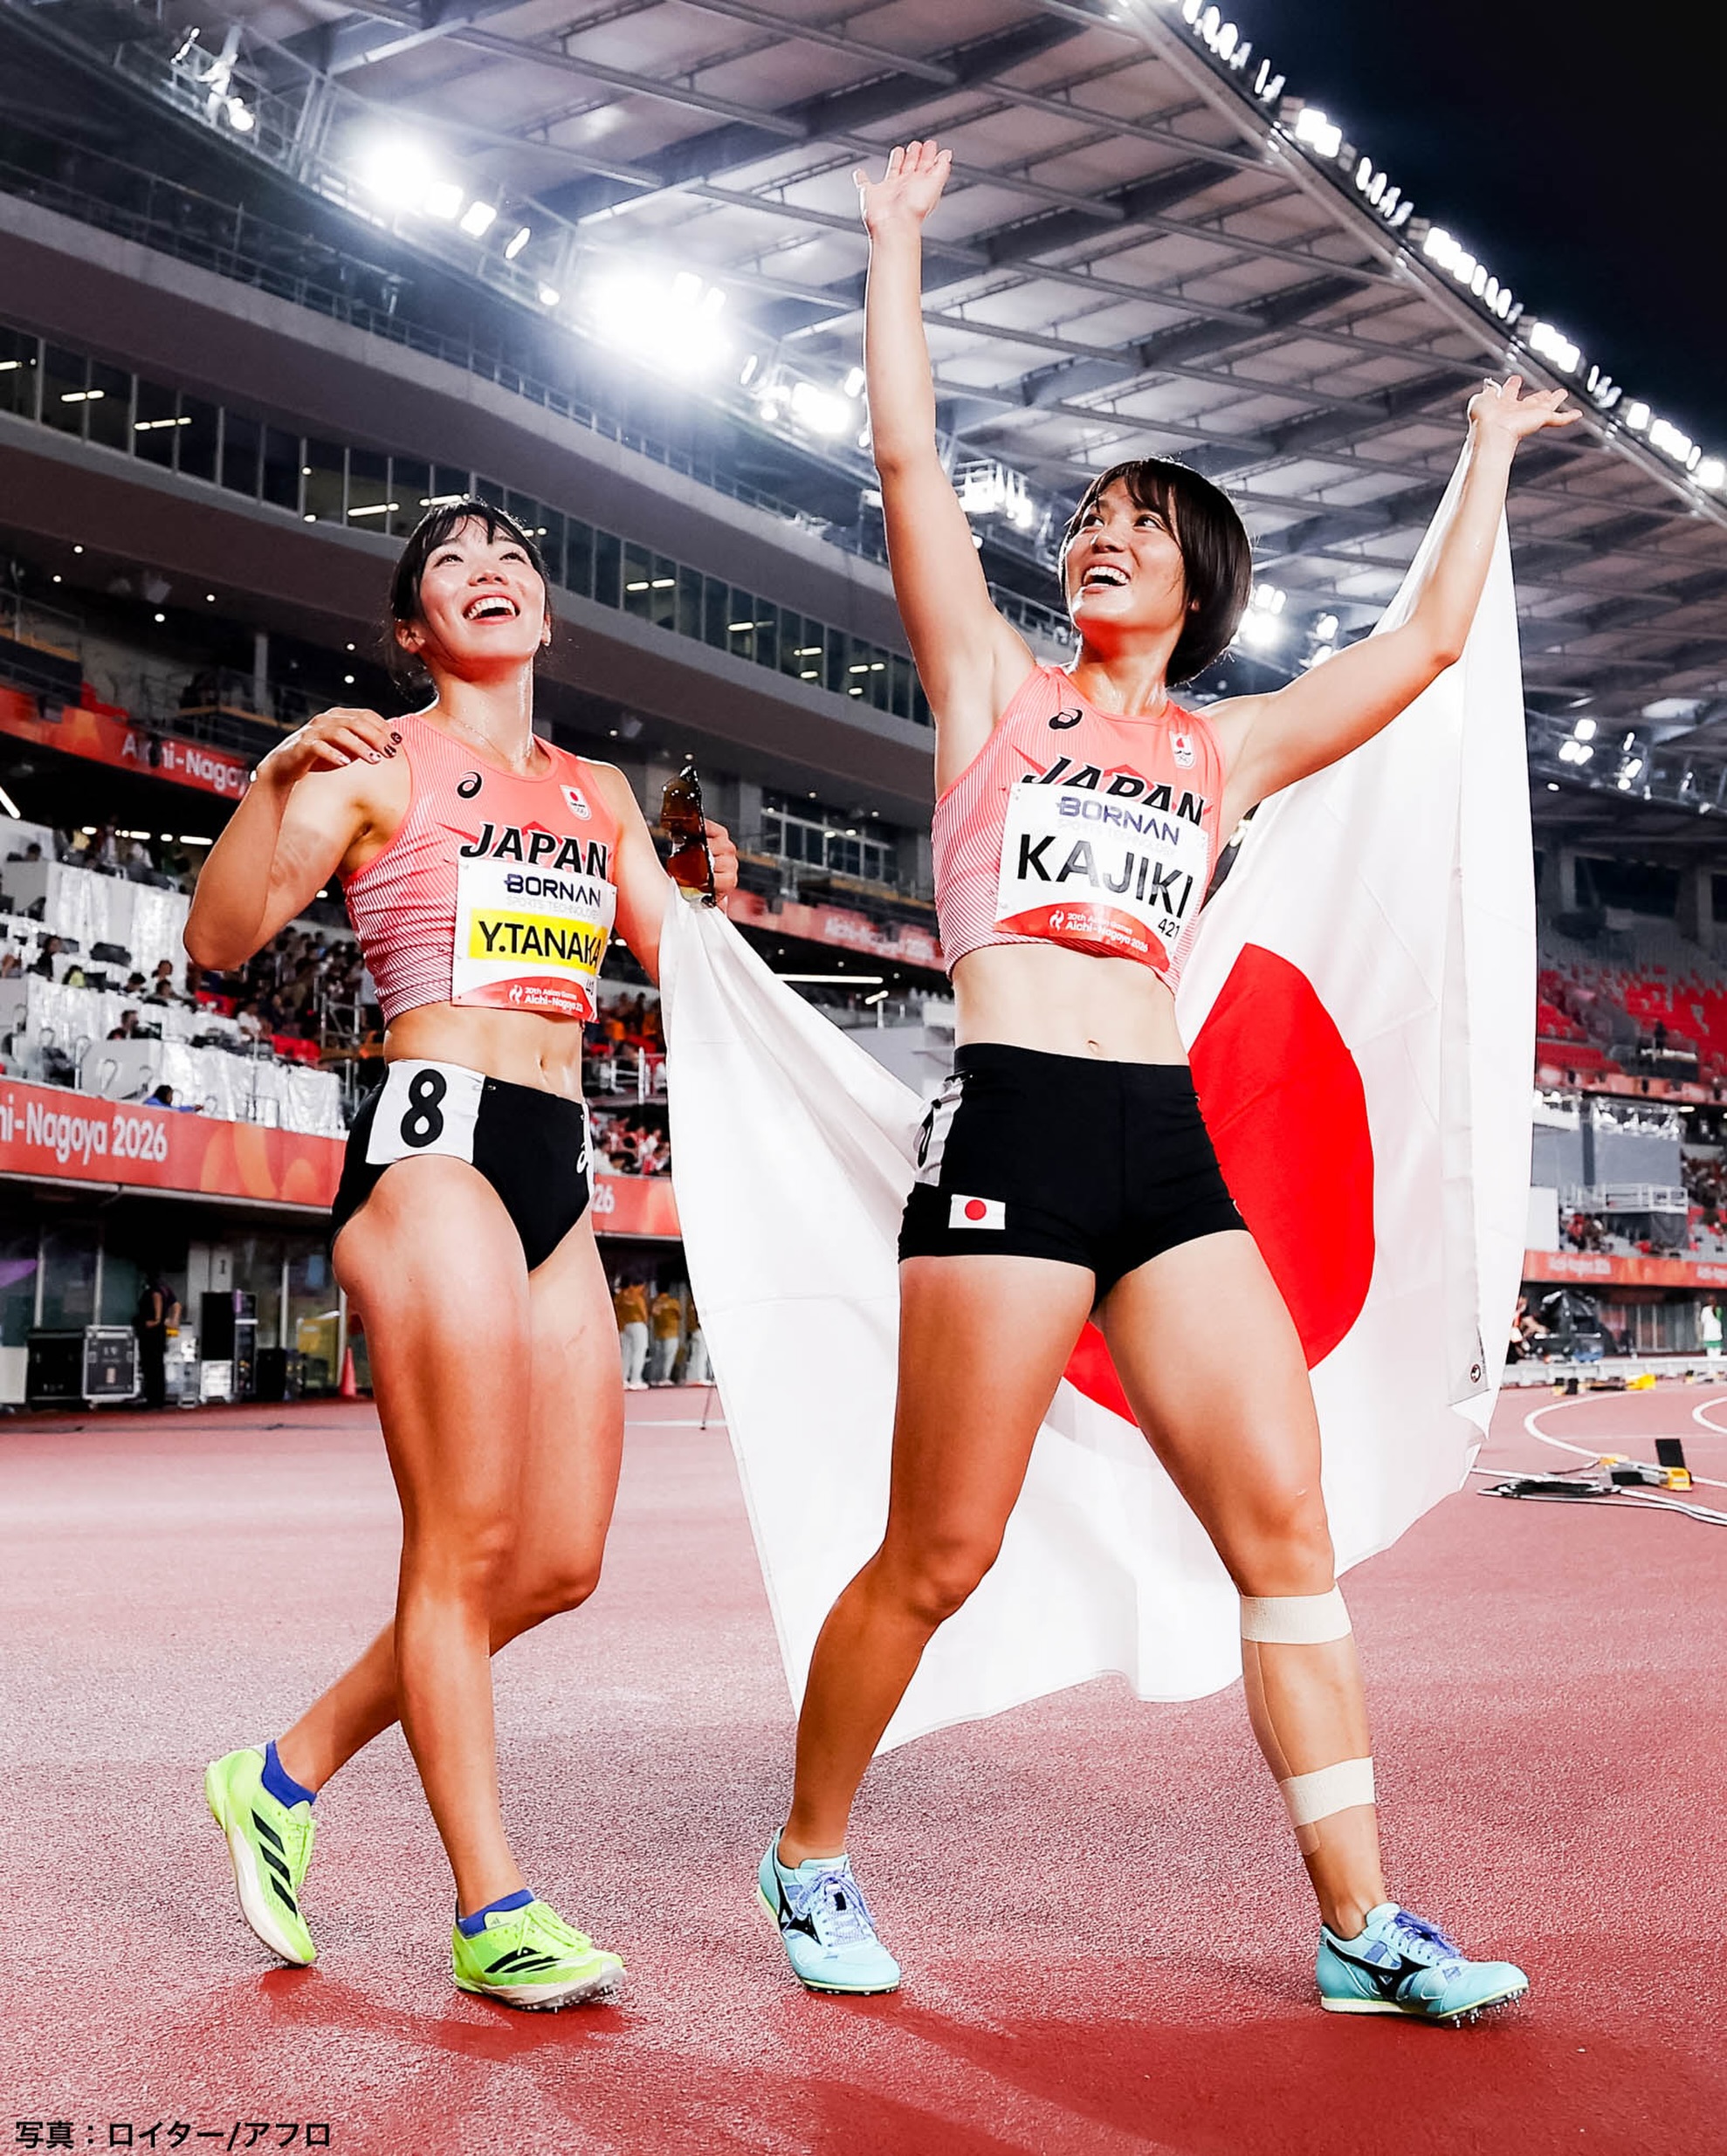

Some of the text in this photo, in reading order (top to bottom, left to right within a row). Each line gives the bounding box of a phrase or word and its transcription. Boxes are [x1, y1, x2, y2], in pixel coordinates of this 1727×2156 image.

[1020, 756, 1206, 826] JAPAN
[1056, 796, 1180, 846] BORNAN
[459, 823, 608, 881] JAPAN
[1017, 834, 1194, 919] KAJIKI
[504, 873, 601, 908] BORNAN
[1065, 920, 1132, 944] Aichi-Nagoya
[1130, 937, 1149, 953] 2026
[1067, 911, 1086, 922] 20th
[478, 920, 602, 969] Y.TANAKA
[400, 1068, 447, 1149] 8
[111, 1115, 169, 1163] 2026
